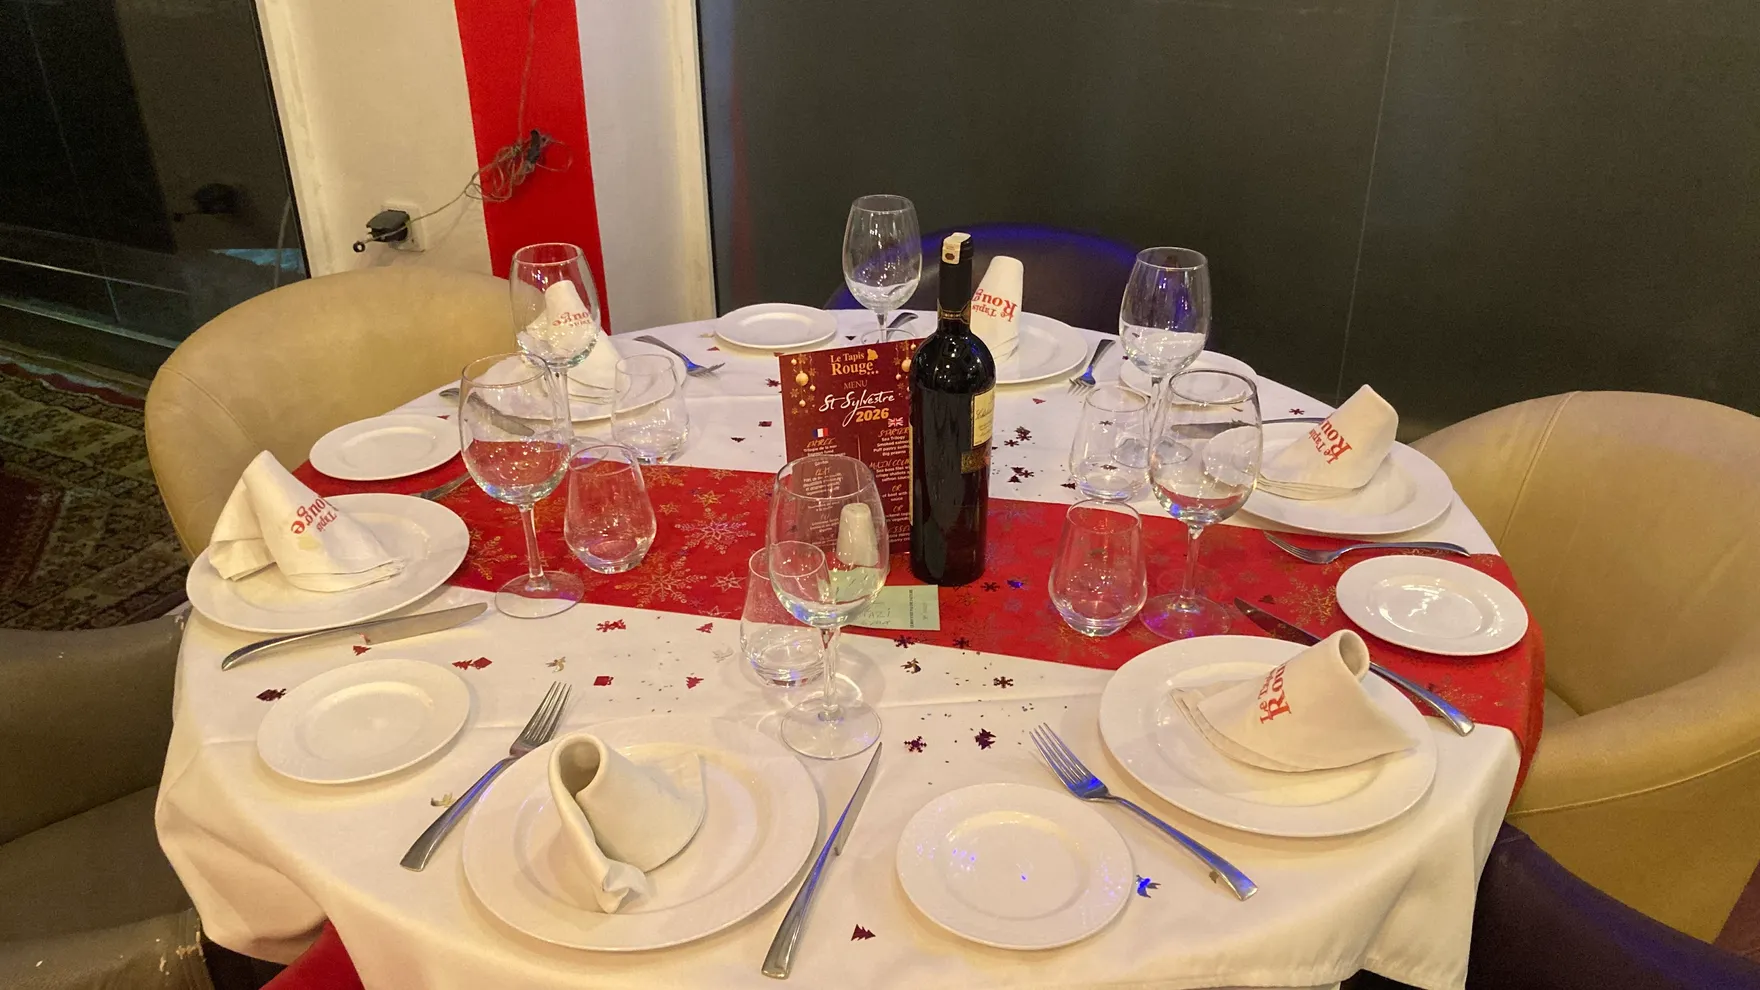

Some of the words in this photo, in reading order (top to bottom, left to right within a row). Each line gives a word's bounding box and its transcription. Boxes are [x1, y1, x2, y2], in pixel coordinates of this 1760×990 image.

[552, 311, 589, 327] ouge
[972, 304, 997, 318] Tapis
[830, 354, 841, 363] Le
[843, 351, 865, 362] Tapis
[843, 380, 868, 390] MENU
[819, 394, 846, 412] St
[840, 389, 895, 427] Sylvestre
[855, 408, 890, 423] 2026
[1320, 420, 1352, 458] Rou
[1323, 448, 1338, 464] Le
[891, 484, 902, 492] OR
[291, 498, 326, 534] ouge
[316, 511, 338, 532] Tapis
[1268, 665, 1292, 720] Rou
[1260, 701, 1274, 724] Le
